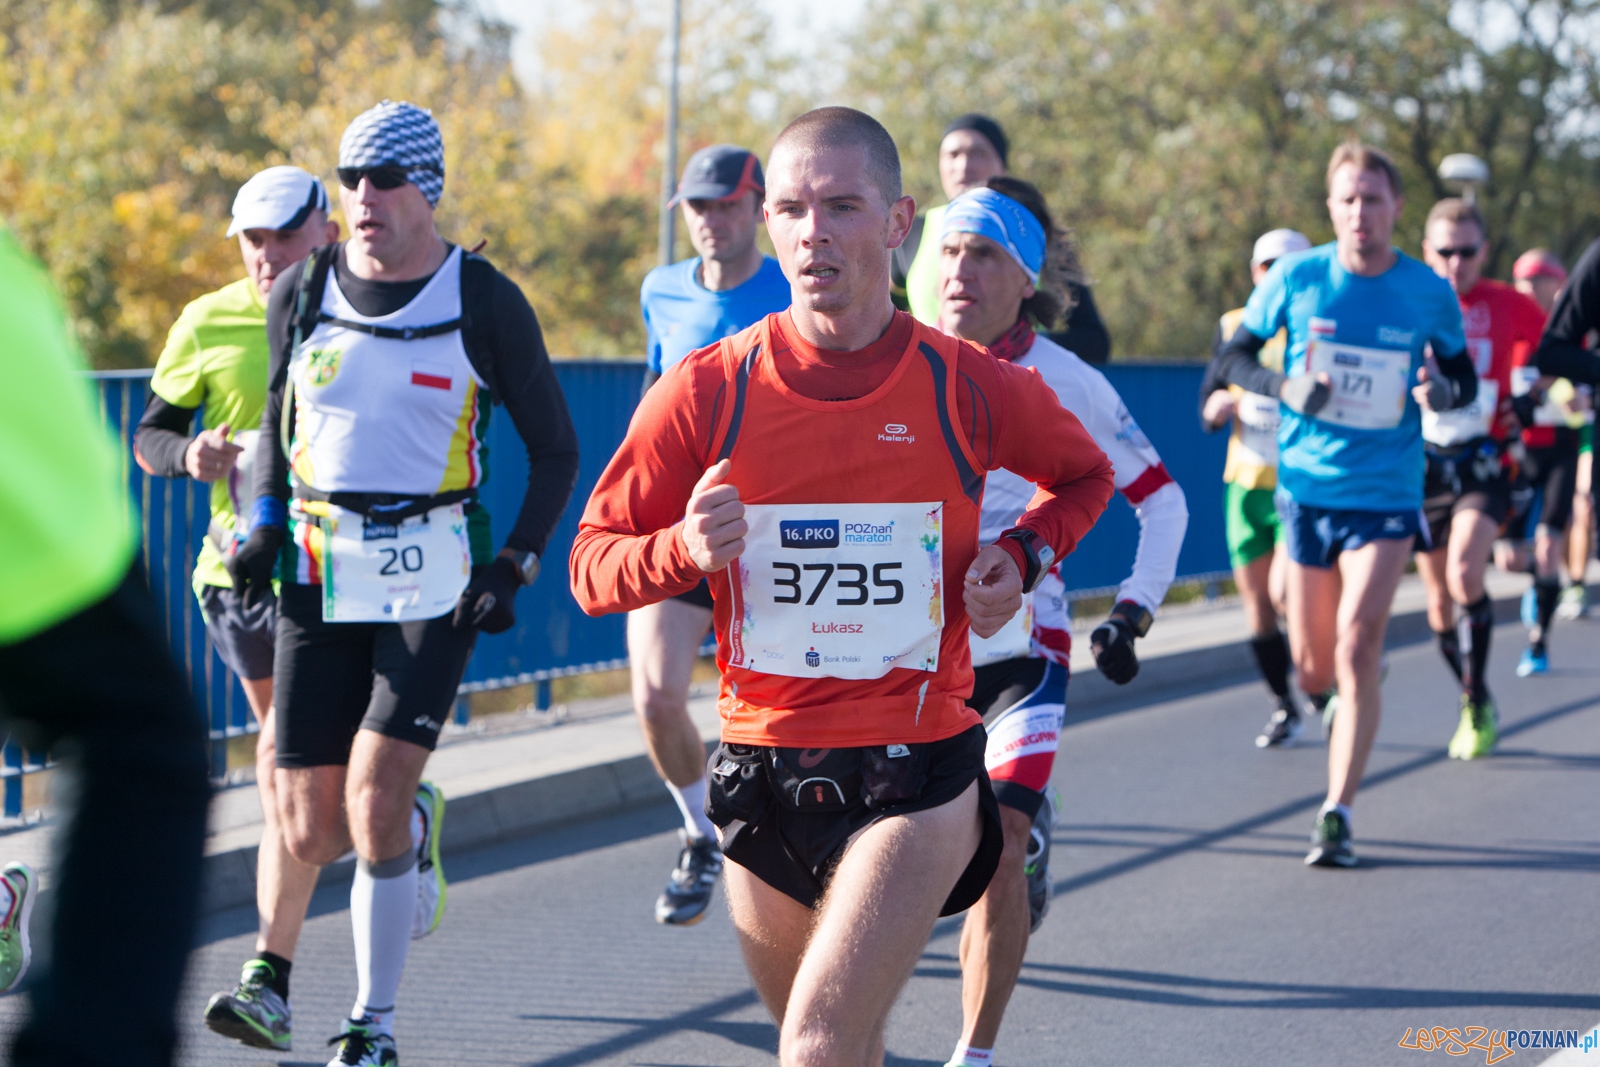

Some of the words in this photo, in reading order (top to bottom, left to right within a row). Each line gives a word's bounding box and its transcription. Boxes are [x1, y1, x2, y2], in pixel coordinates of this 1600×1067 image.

[877, 434, 915, 444] Kalenji
[784, 528, 803, 541] 16.
[804, 527, 835, 541] PKO
[844, 533, 892, 543] maraton
[379, 545, 423, 576] 20
[772, 561, 904, 606] 3735
[811, 622, 864, 634] Łukasz
